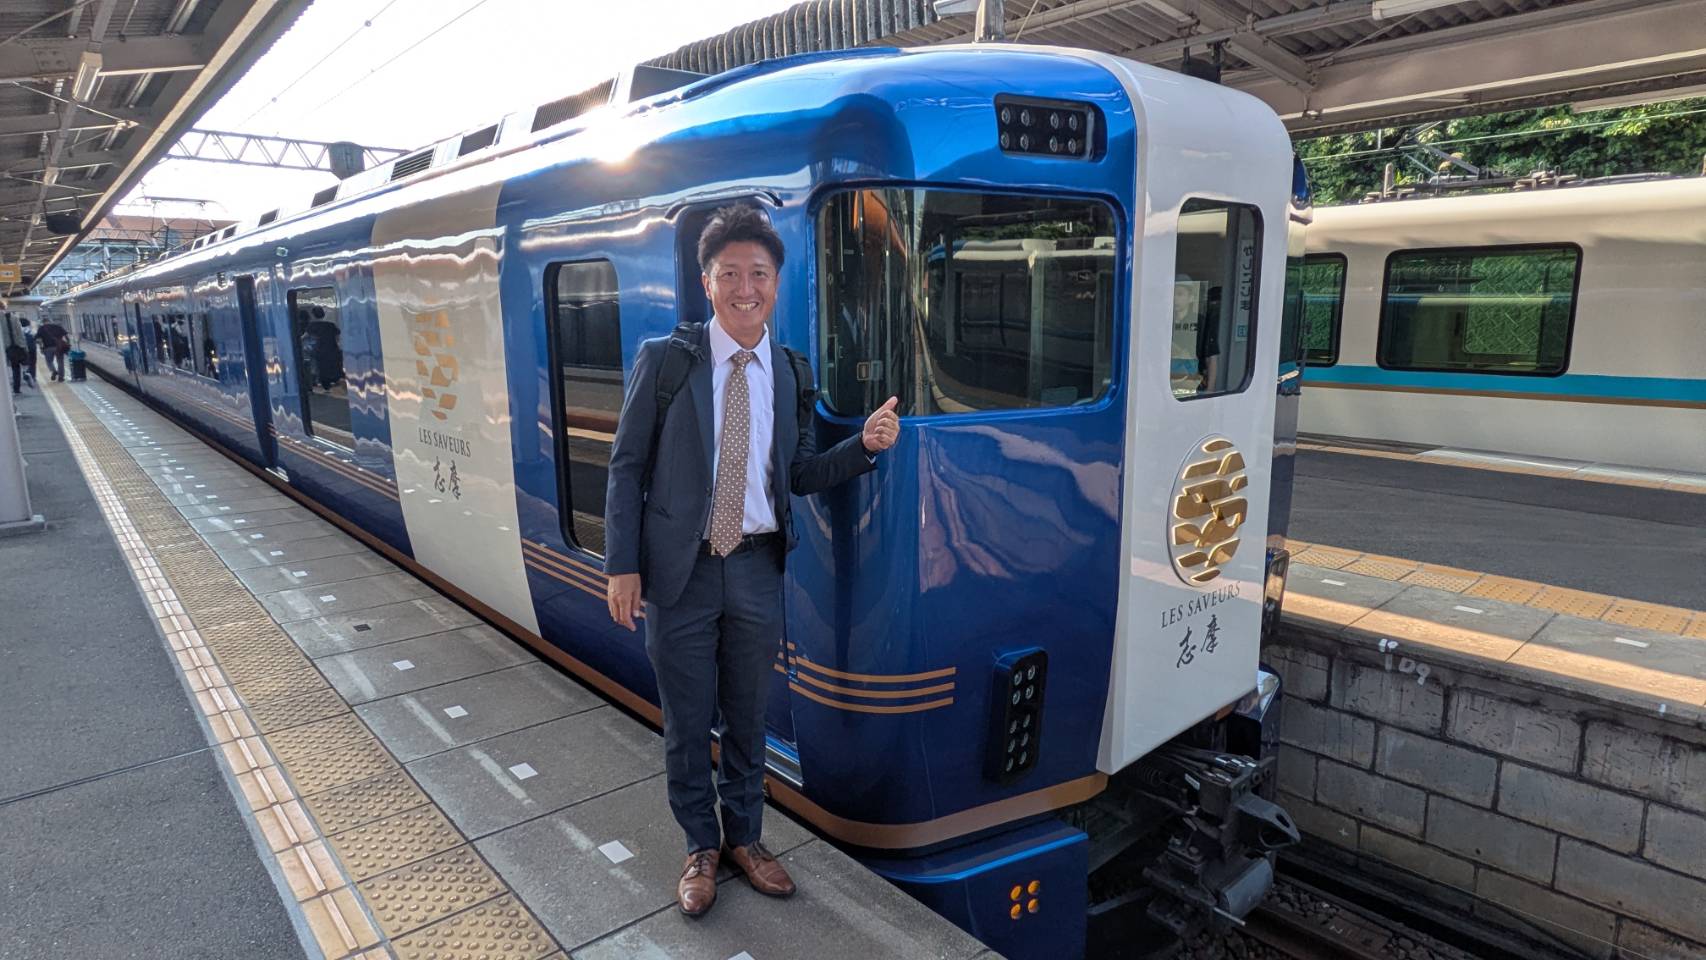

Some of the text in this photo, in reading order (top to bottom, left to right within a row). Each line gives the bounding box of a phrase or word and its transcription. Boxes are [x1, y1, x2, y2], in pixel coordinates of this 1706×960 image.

[419, 427, 471, 458] LES SAVEURS
[433, 455, 461, 500] 志摩
[1161, 580, 1241, 628] LES SAVEURS
[1176, 613, 1221, 669] 志摩
